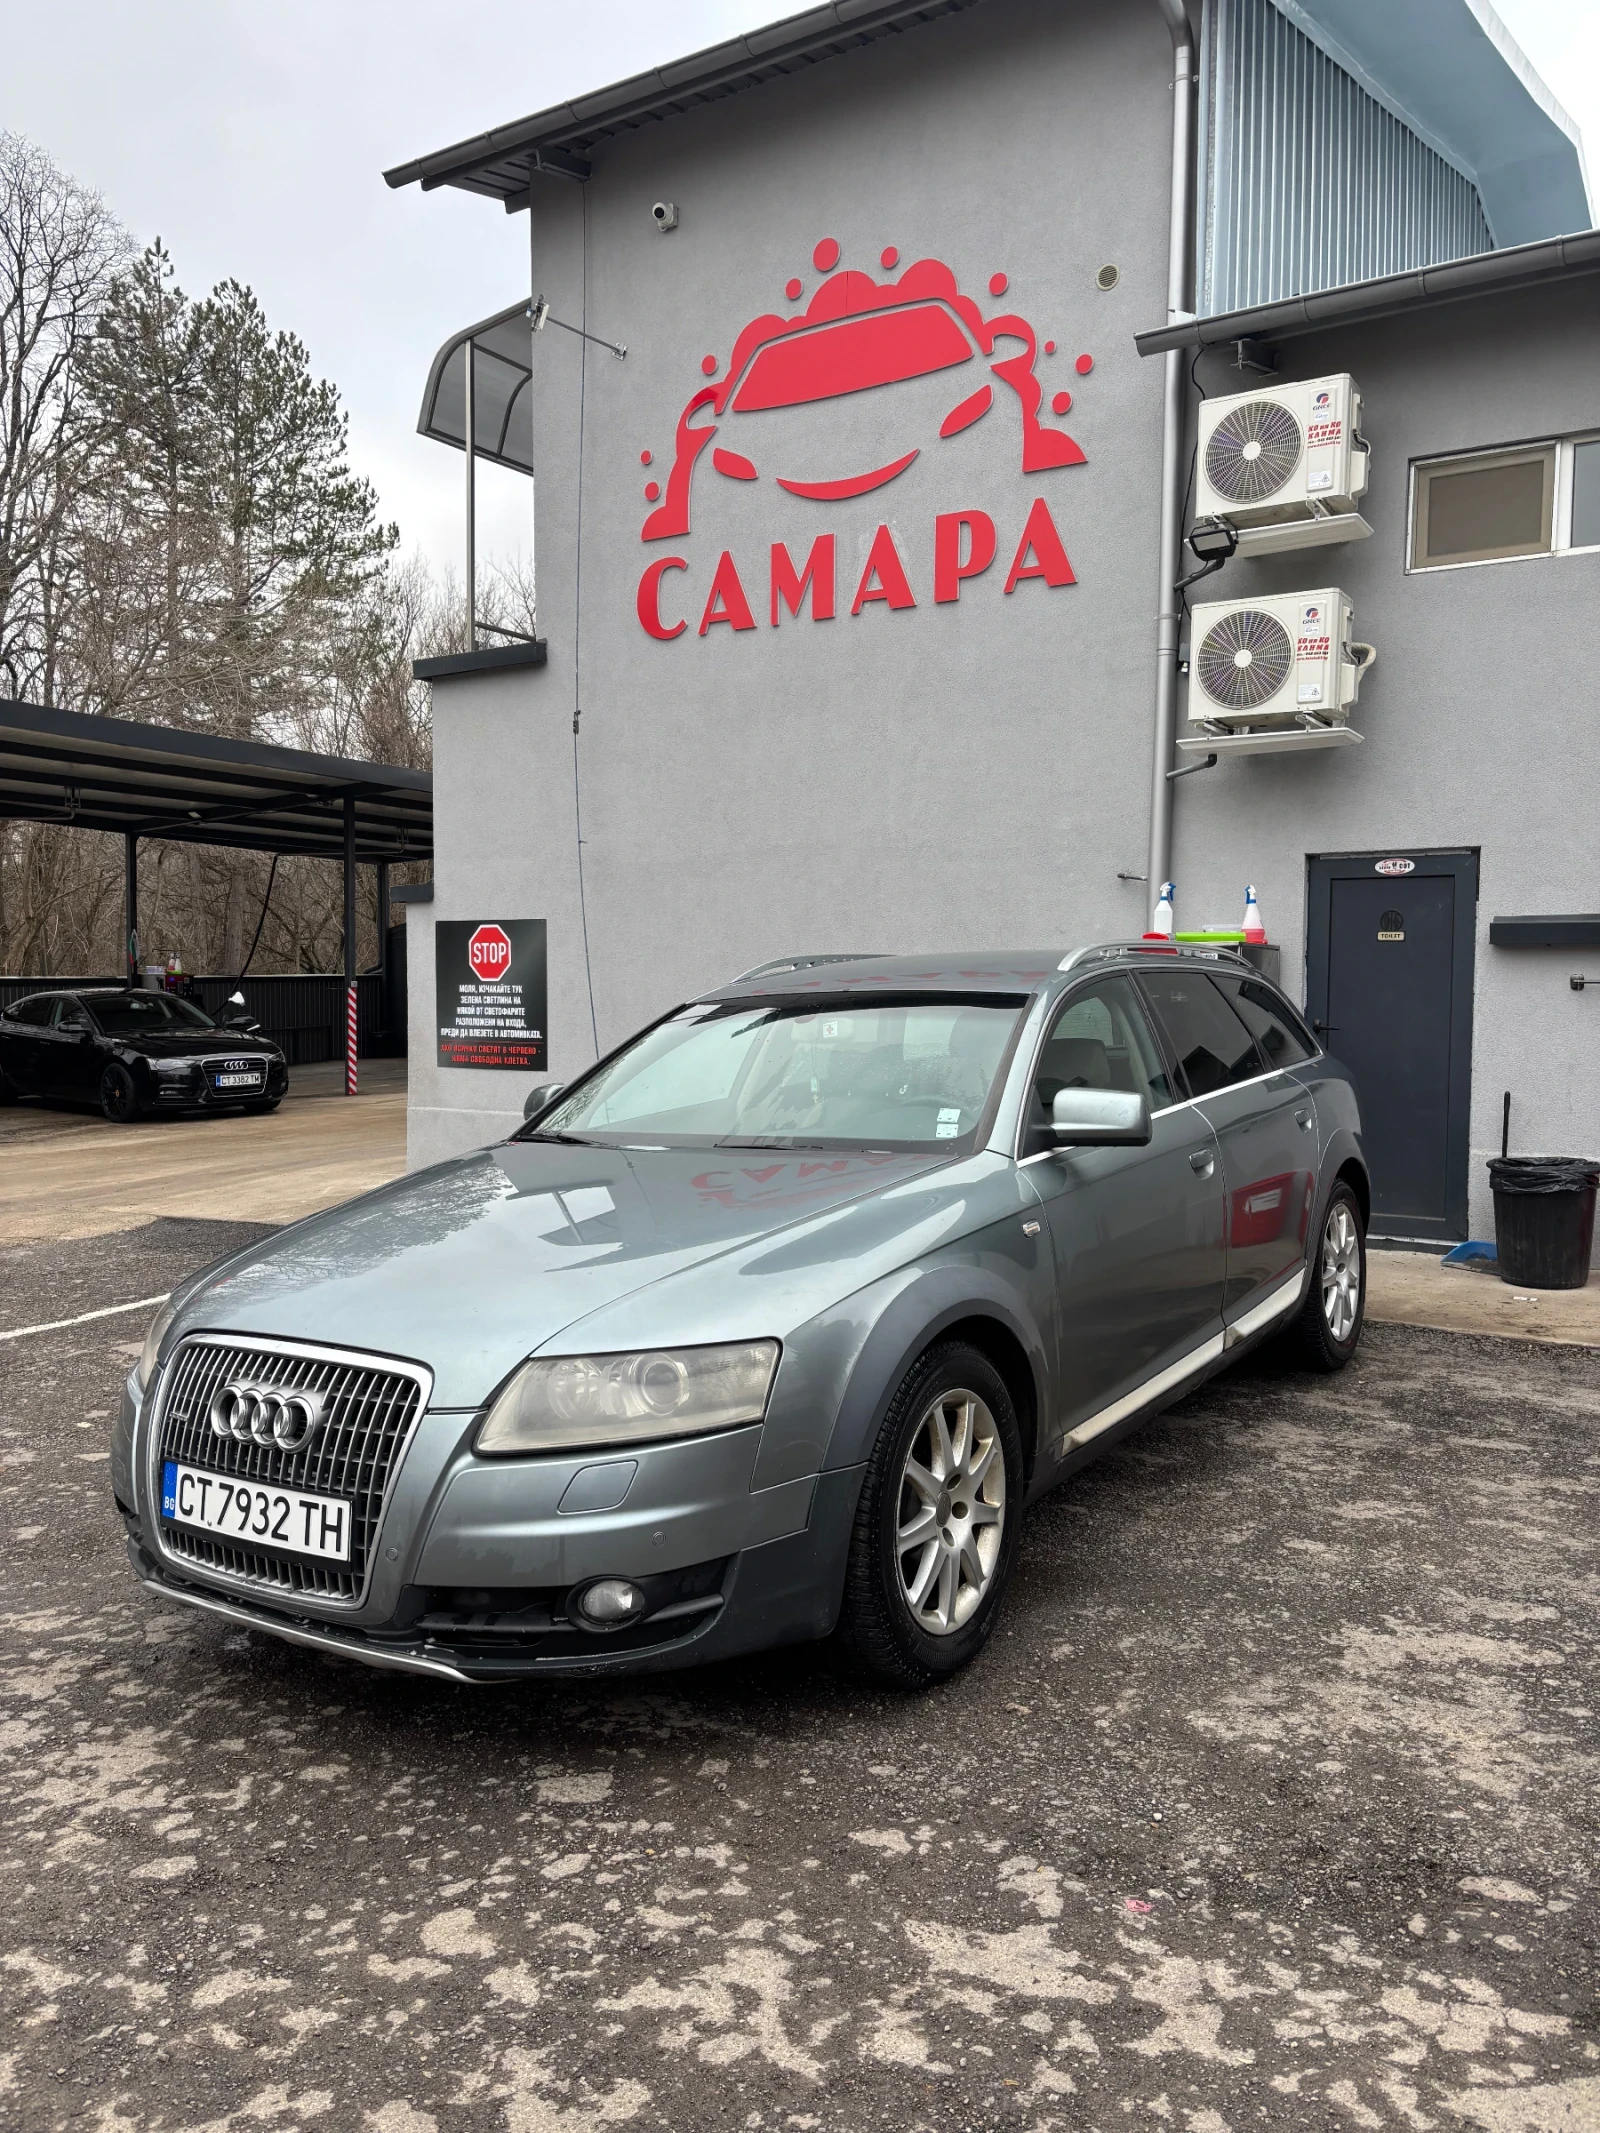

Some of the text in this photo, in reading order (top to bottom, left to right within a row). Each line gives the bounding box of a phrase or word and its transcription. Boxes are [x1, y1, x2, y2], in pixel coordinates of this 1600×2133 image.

[636, 497, 1078, 640] САМАРА
[473, 942, 507, 964] STOP
[459, 984, 523, 994] МОЛЯ, ИЗЧАКАЙТЕ ТУК
[460, 995, 521, 1005] ЗЕЛЕНА СВЕТЛИНА НА
[457, 1005, 526, 1016] НЯКОЙ ОТ СВЕТОФАРИТЕ
[455, 1017, 527, 1028] РАЗПОЛОЖЕНИ НА ВХОДА,
[441, 1028, 543, 1039] ПРЕДИ ДА ВЛЕЗЕТЕ В АВТОМИВКАТА.
[478, 1045, 501, 1054] СВЕТЯТ
[508, 1046, 537, 1055] ЧЕРВЕНО
[470, 1056, 502, 1065] СВОБОДНА
[232, 1075, 250, 1085] 3382
[164, 1495, 175, 1511] BG
[178, 1473, 344, 1553] CT 7932 TH
